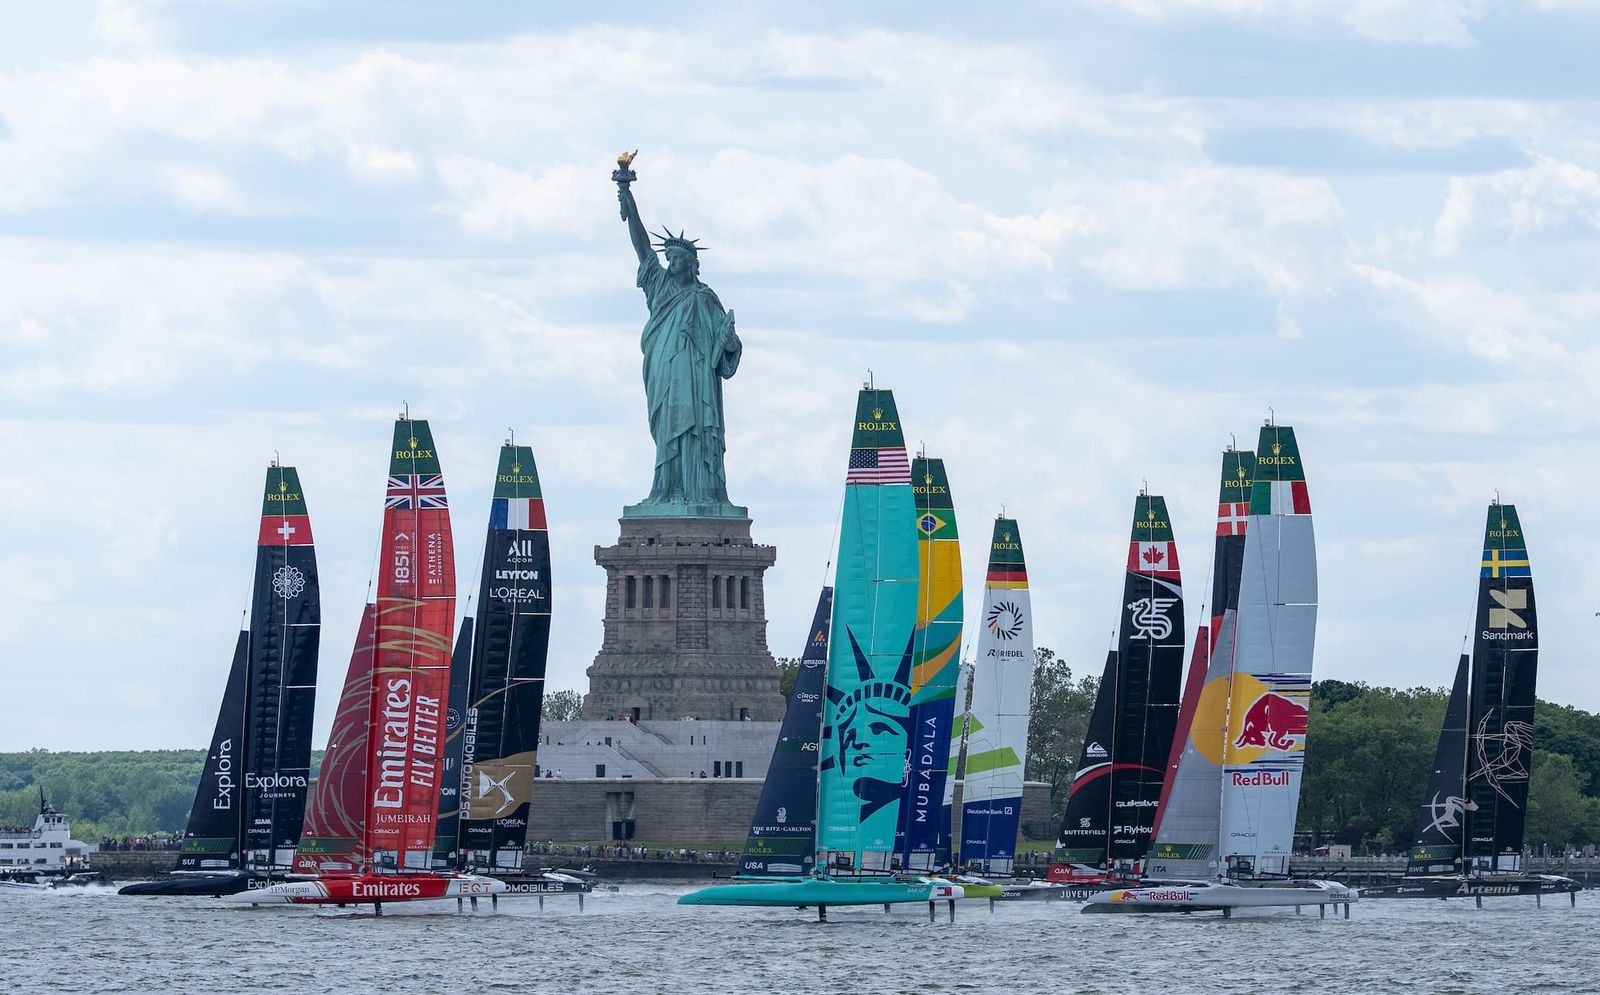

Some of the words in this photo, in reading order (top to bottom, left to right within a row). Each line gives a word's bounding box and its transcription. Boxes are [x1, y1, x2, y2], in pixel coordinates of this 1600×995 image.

[858, 422, 897, 431] ROLEX
[396, 450, 433, 459] ROLEX
[1258, 456, 1295, 465] ROLEX
[499, 475, 534, 484] ROLEX
[1225, 480, 1254, 488] ROLE
[912, 486, 946, 494] ROLEX
[267, 493, 299, 501] ROLEX
[496, 570, 538, 580] LEYTON
[1482, 630, 1534, 640] Sandmark
[413, 695, 440, 754] BETTER
[374, 678, 411, 808] Emirates
[801, 742, 819, 751] AG1
[461, 708, 478, 800] AUTOMOBILES
[214, 738, 235, 810] Explora
[411, 755, 434, 788] FLY
[916, 717, 937, 822] MUBADALA
[245, 772, 307, 792] Explora
[1232, 772, 1261, 786] Red
[1262, 771, 1289, 786] Bull
[460, 801, 471, 820] DS
[375, 813, 431, 825] JUMEIRAH
[1123, 826, 1153, 835] FlyHou
[298, 860, 317, 868] GBR
[745, 861, 764, 869] USA
[352, 881, 420, 896] Emirates
[459, 883, 491, 893] EQT
[1456, 882, 1520, 894] Artemis
[1149, 891, 1169, 901] Red
[1170, 891, 1190, 901] Bull
